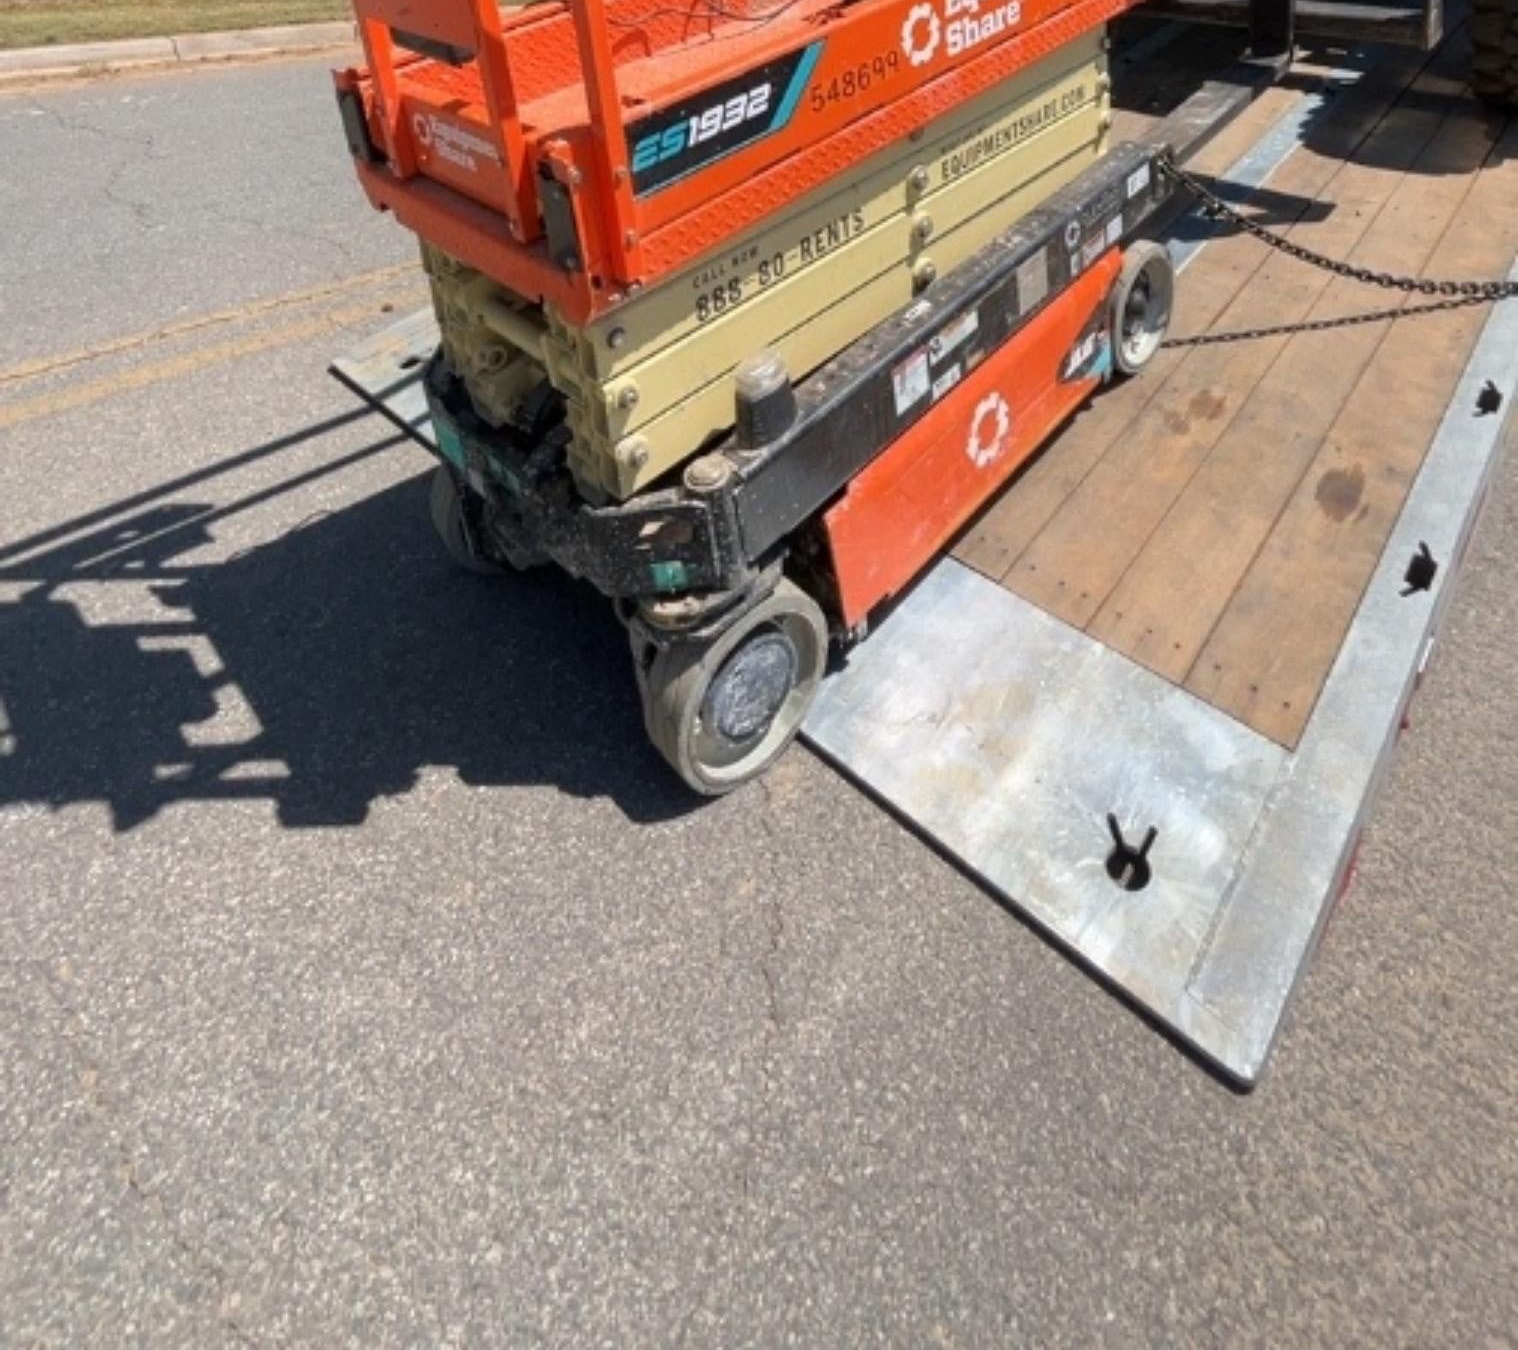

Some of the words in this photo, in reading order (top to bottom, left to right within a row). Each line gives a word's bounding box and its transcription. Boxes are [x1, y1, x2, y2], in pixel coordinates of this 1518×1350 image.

[946, 0, 1022, 56] Share
[809, 51, 899, 114] 548699
[632, 82, 772, 173] ES1932
[695, 205, 866, 323] 888-80-RENTS
